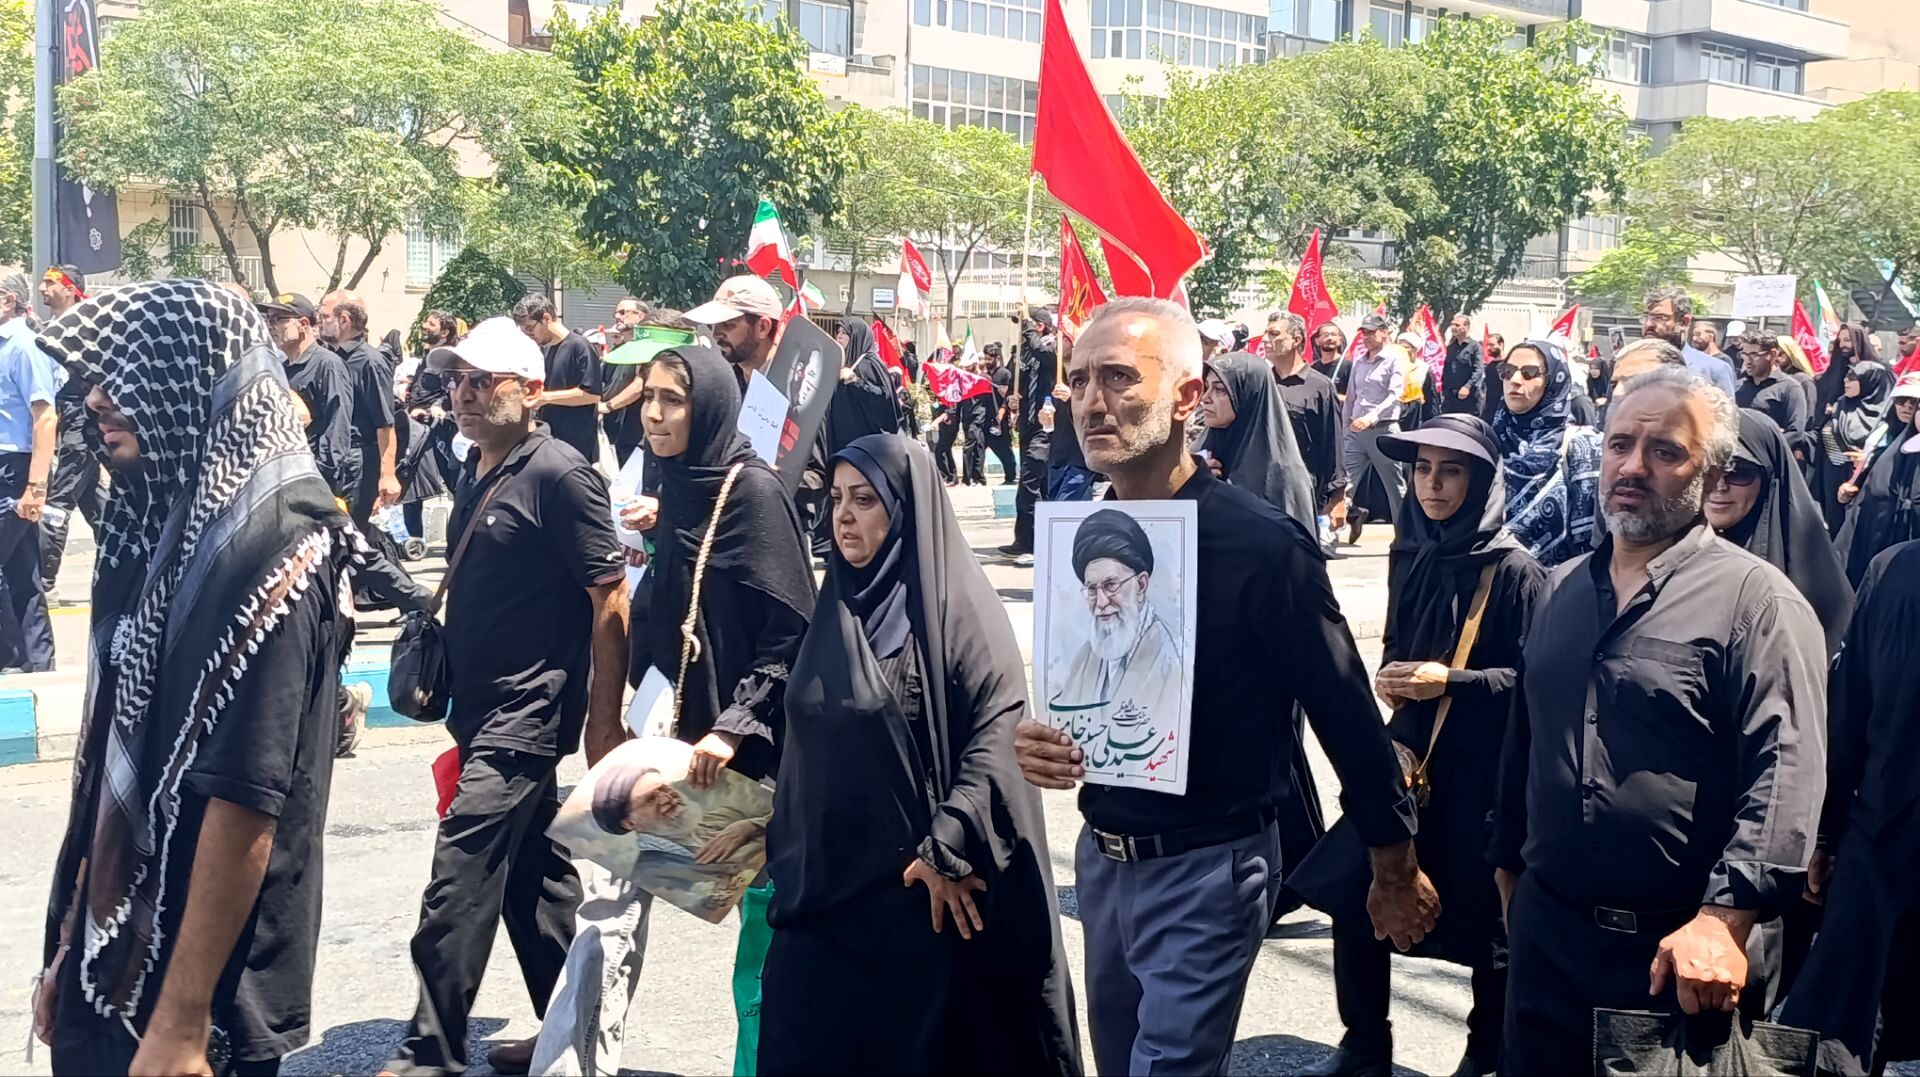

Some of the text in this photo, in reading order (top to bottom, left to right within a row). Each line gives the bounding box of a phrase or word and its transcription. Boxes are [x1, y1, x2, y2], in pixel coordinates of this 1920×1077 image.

[1092, 726, 1158, 768] علی
[1107, 737, 1166, 778] سید
[1143, 730, 1176, 782] شهید
